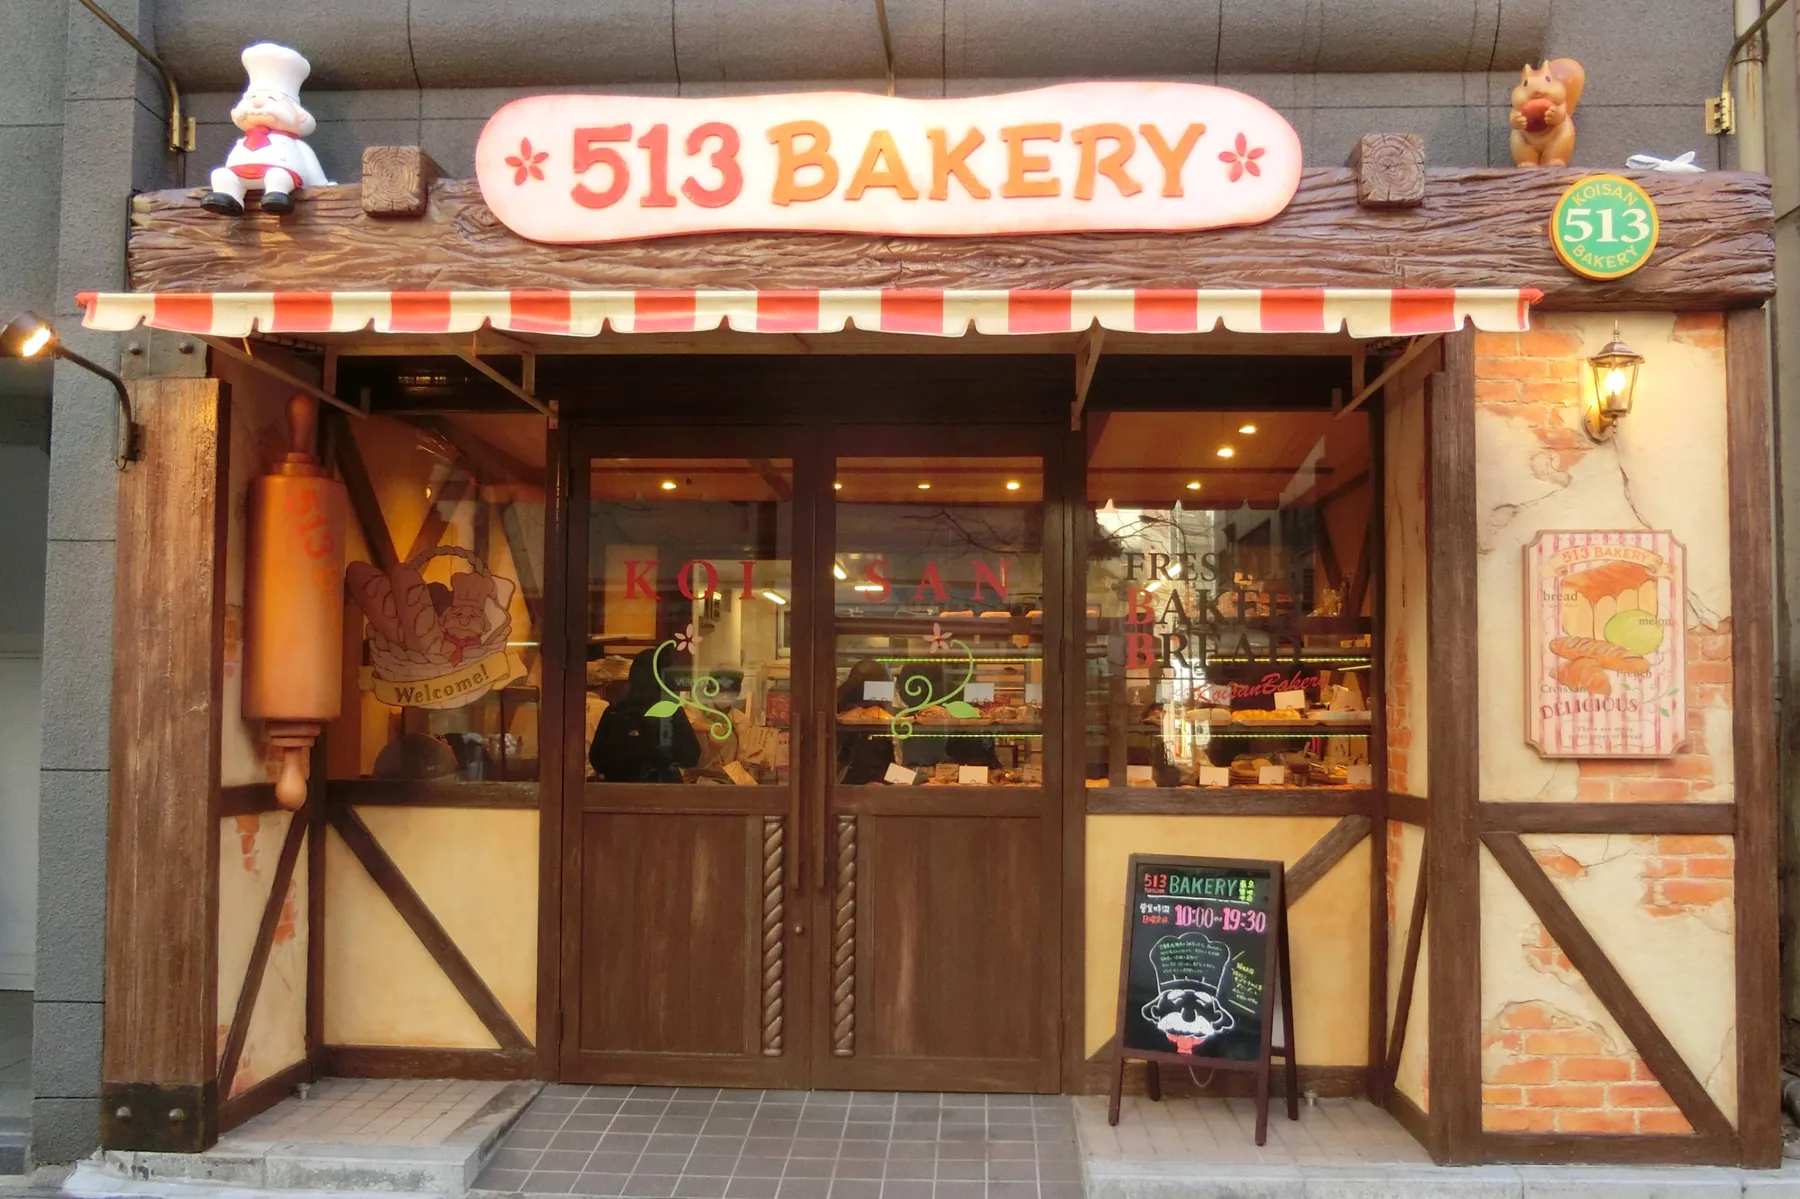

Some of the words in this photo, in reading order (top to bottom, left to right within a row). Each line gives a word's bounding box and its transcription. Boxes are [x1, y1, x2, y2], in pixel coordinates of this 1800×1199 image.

[571, 121, 744, 209] 513
[766, 119, 1207, 202] BAKERY
[1572, 183, 1638, 206] KOISAN
[1563, 208, 1650, 243] 513
[1572, 244, 1638, 268] BAKERY
[1562, 547, 1589, 563] 513
[1594, 547, 1649, 562] BAKERY
[622, 560, 757, 601] KOI
[864, 560, 1012, 601] SAN
[1543, 590, 1578, 601] bread
[394, 663, 490, 704] Welcome!
[1540, 697, 1638, 720] DELICIOUS
[1144, 873, 1168, 887] 513
[1169, 875, 1238, 897] BAKERY
